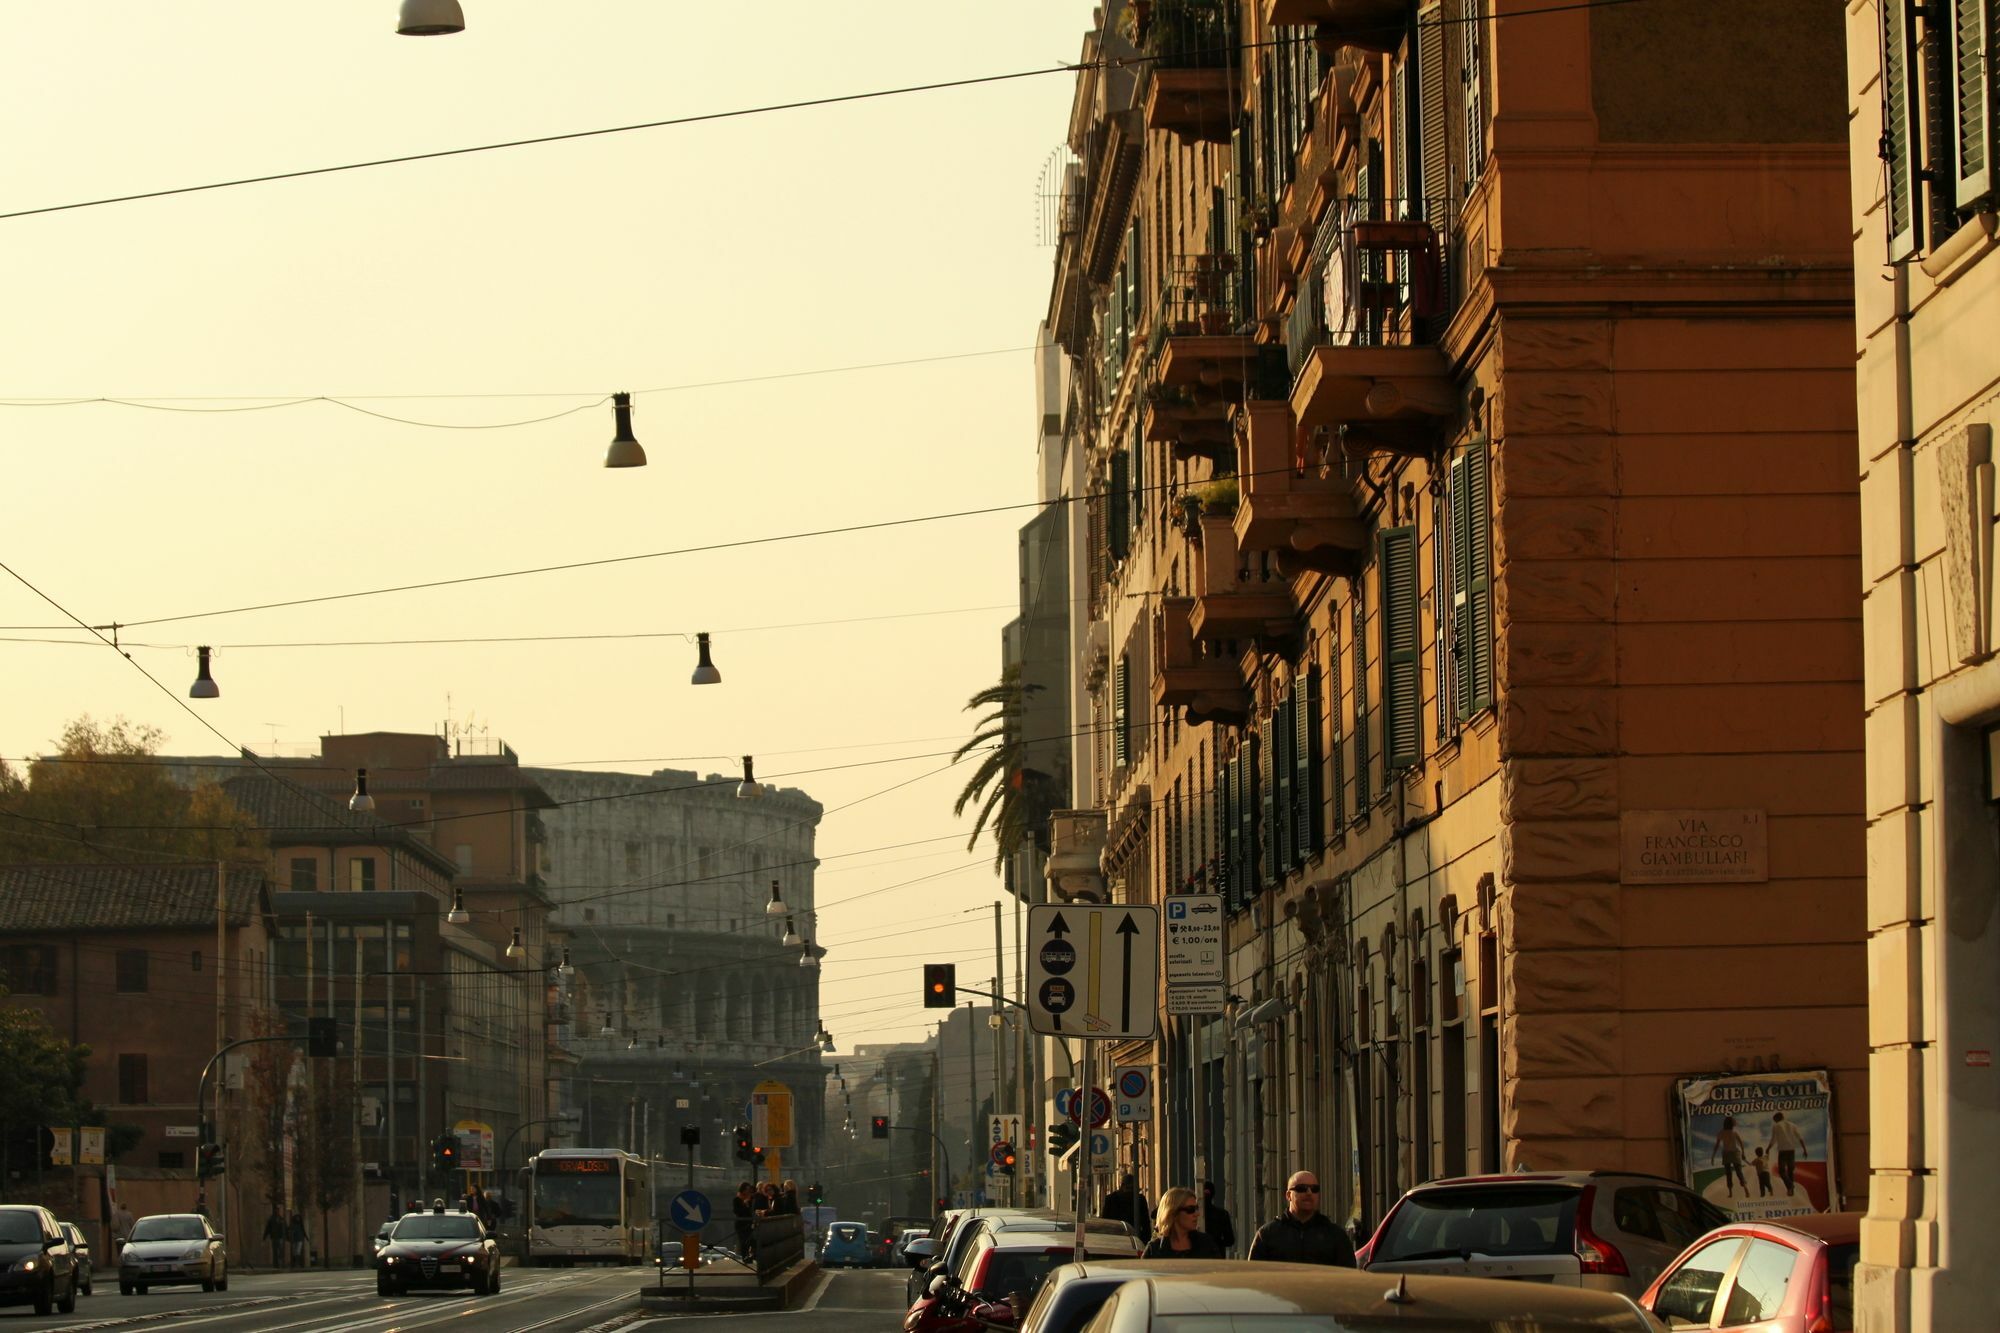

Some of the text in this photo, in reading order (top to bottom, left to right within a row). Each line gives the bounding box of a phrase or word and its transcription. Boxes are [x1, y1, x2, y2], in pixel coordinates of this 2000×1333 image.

[1678, 819, 1708, 832] VIA
[1645, 834, 1743, 849] FRANCESCO
[1640, 850, 1748, 865] GIAMBULLARI
[1710, 1083, 1763, 1100] CIETÀ
[1690, 1099, 1775, 1117] Protagonista
[1777, 1100, 1802, 1110] con
